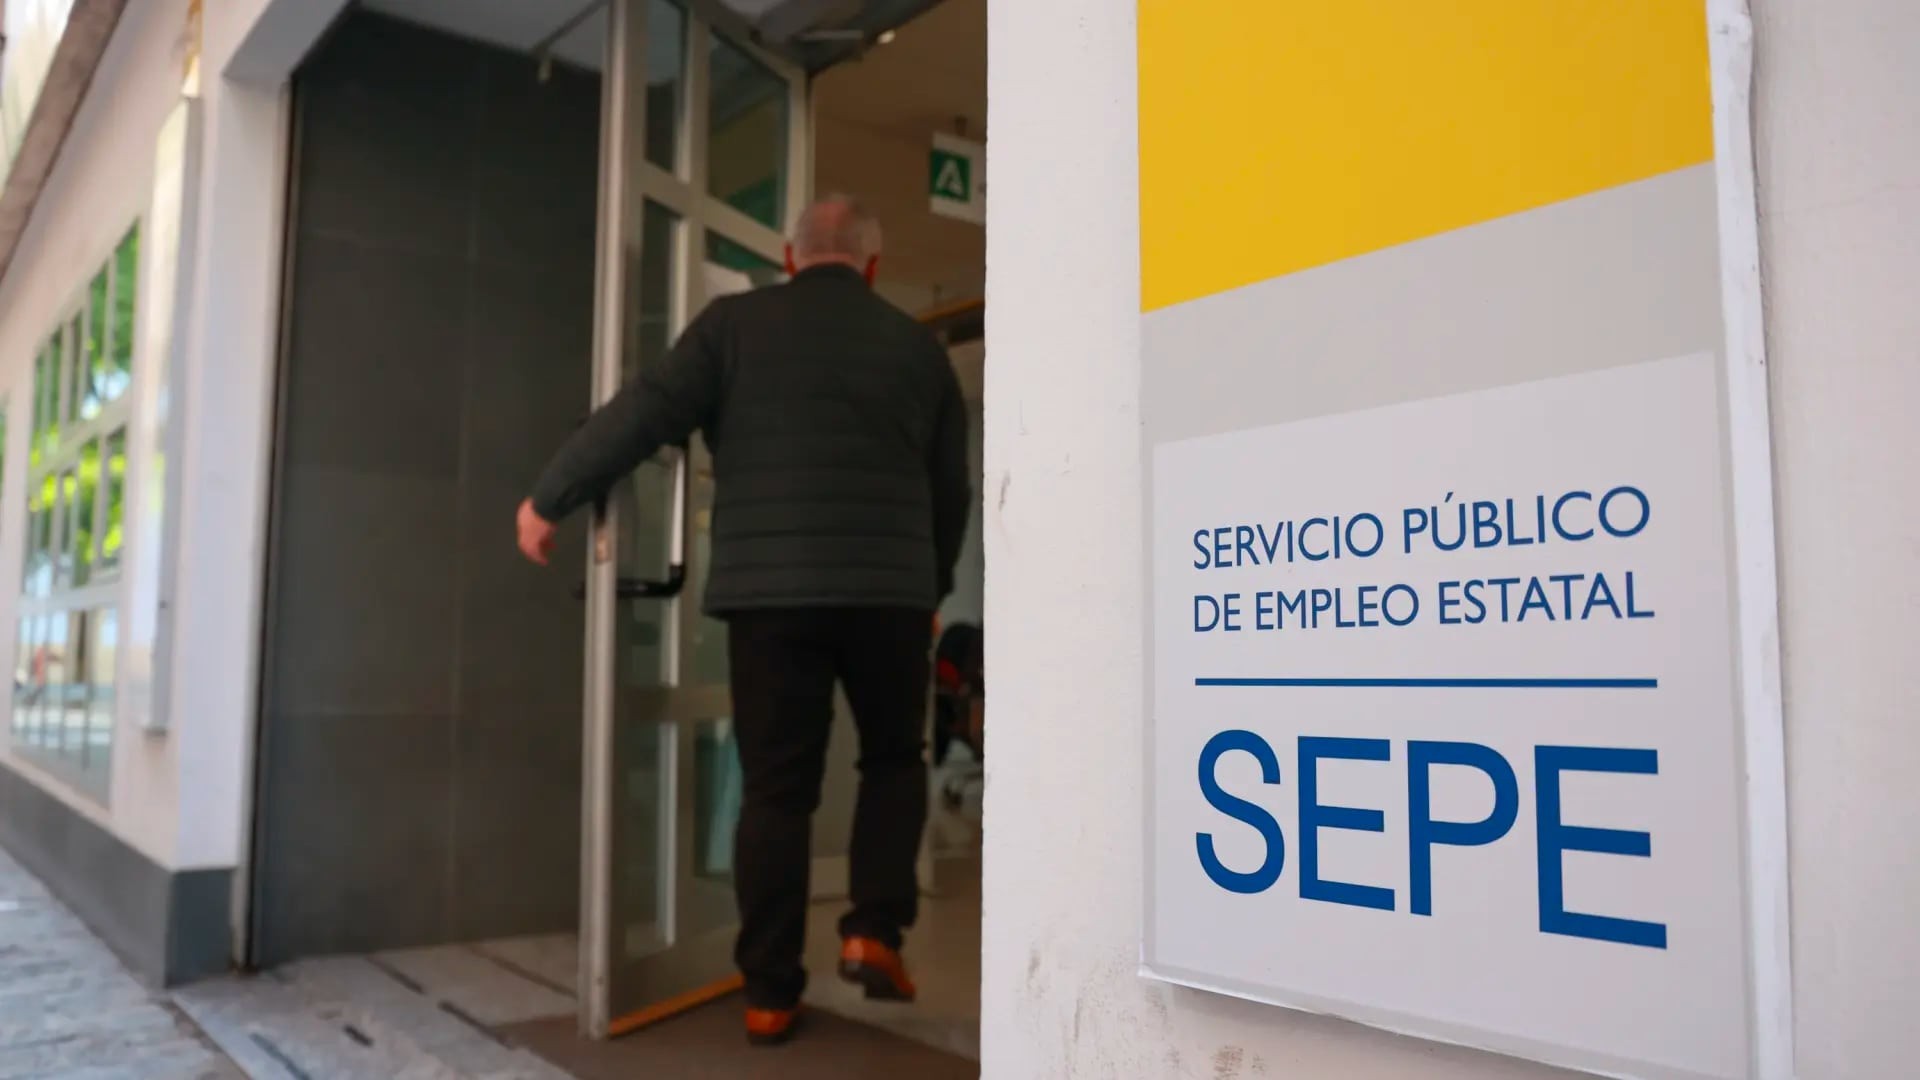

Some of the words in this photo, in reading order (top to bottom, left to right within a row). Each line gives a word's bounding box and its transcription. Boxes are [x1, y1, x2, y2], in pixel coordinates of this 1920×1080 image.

[1193, 512, 1385, 571] SERVICIO
[1403, 486, 1651, 553] PÚBLICO
[1194, 592, 1241, 633] DE
[1255, 583, 1420, 631] EMPLEO
[1438, 571, 1655, 625] ESTATAL
[1195, 729, 1668, 950] SEPE
